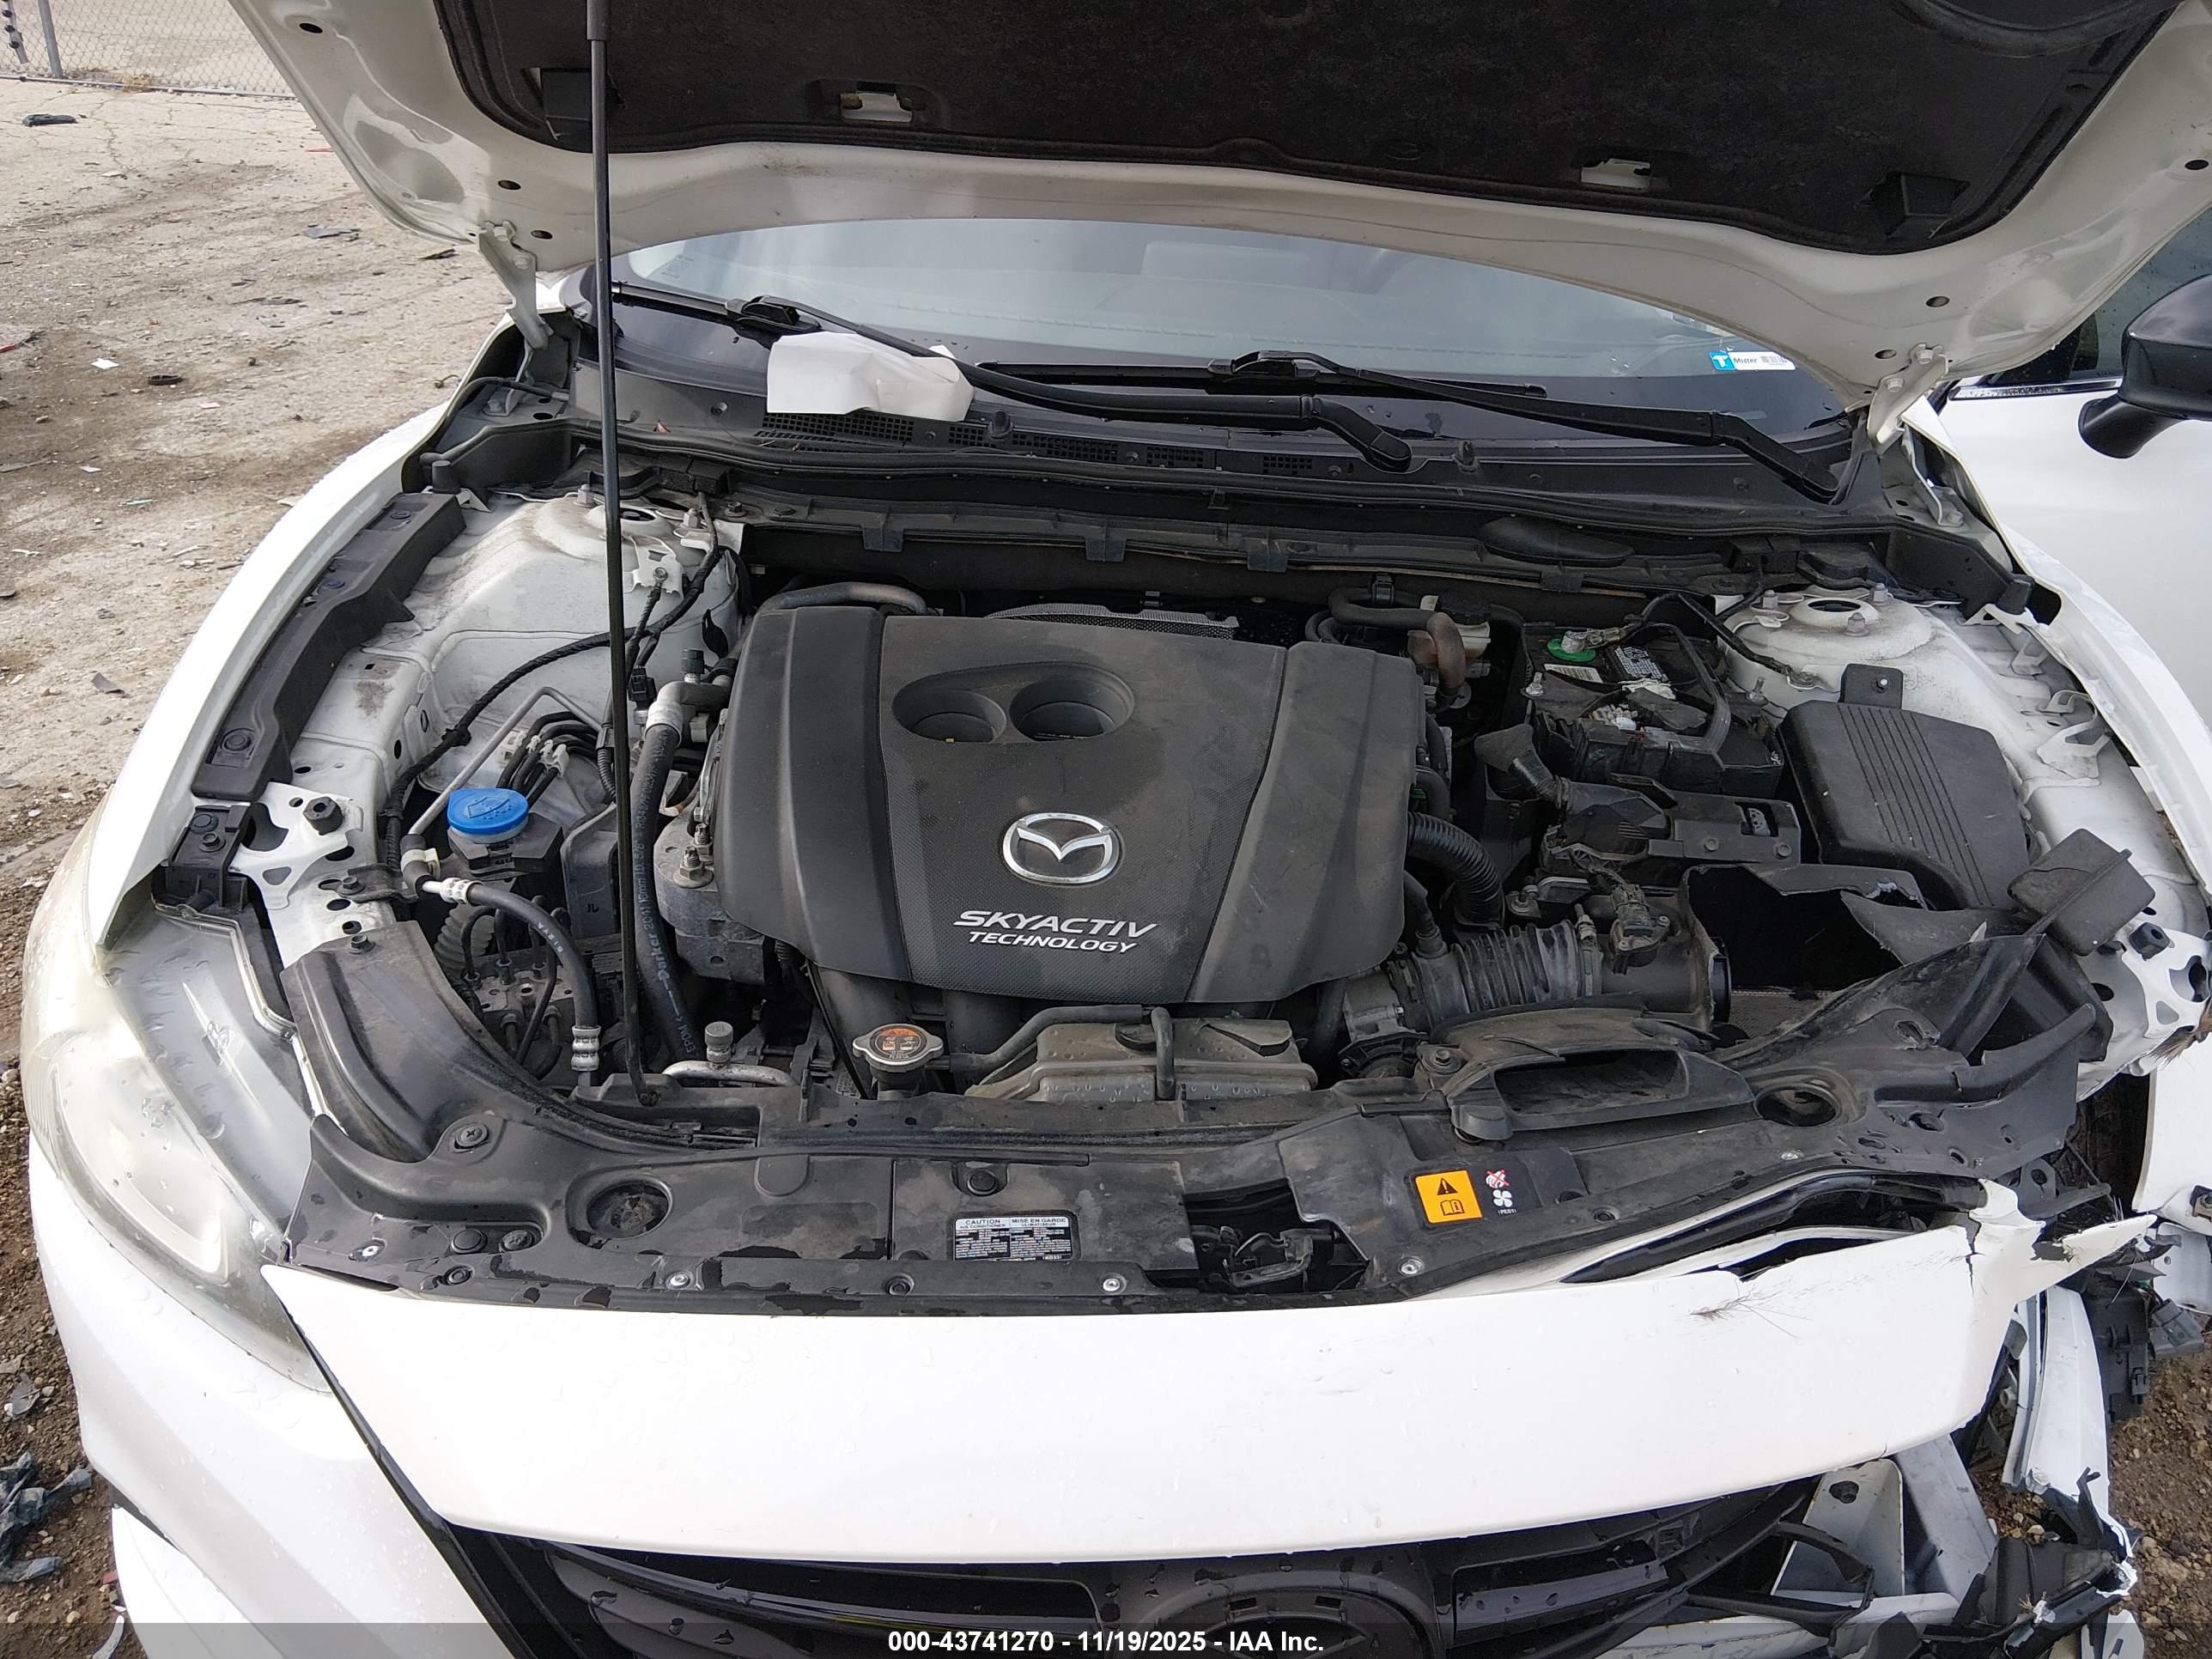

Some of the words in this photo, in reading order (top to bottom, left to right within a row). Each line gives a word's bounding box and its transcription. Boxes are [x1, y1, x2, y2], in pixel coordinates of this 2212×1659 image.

[953, 910, 1158, 938] SKYACTIV
[969, 931, 1138, 953] TECHNOLOGY
[647, 933, 670, 981] Parker
